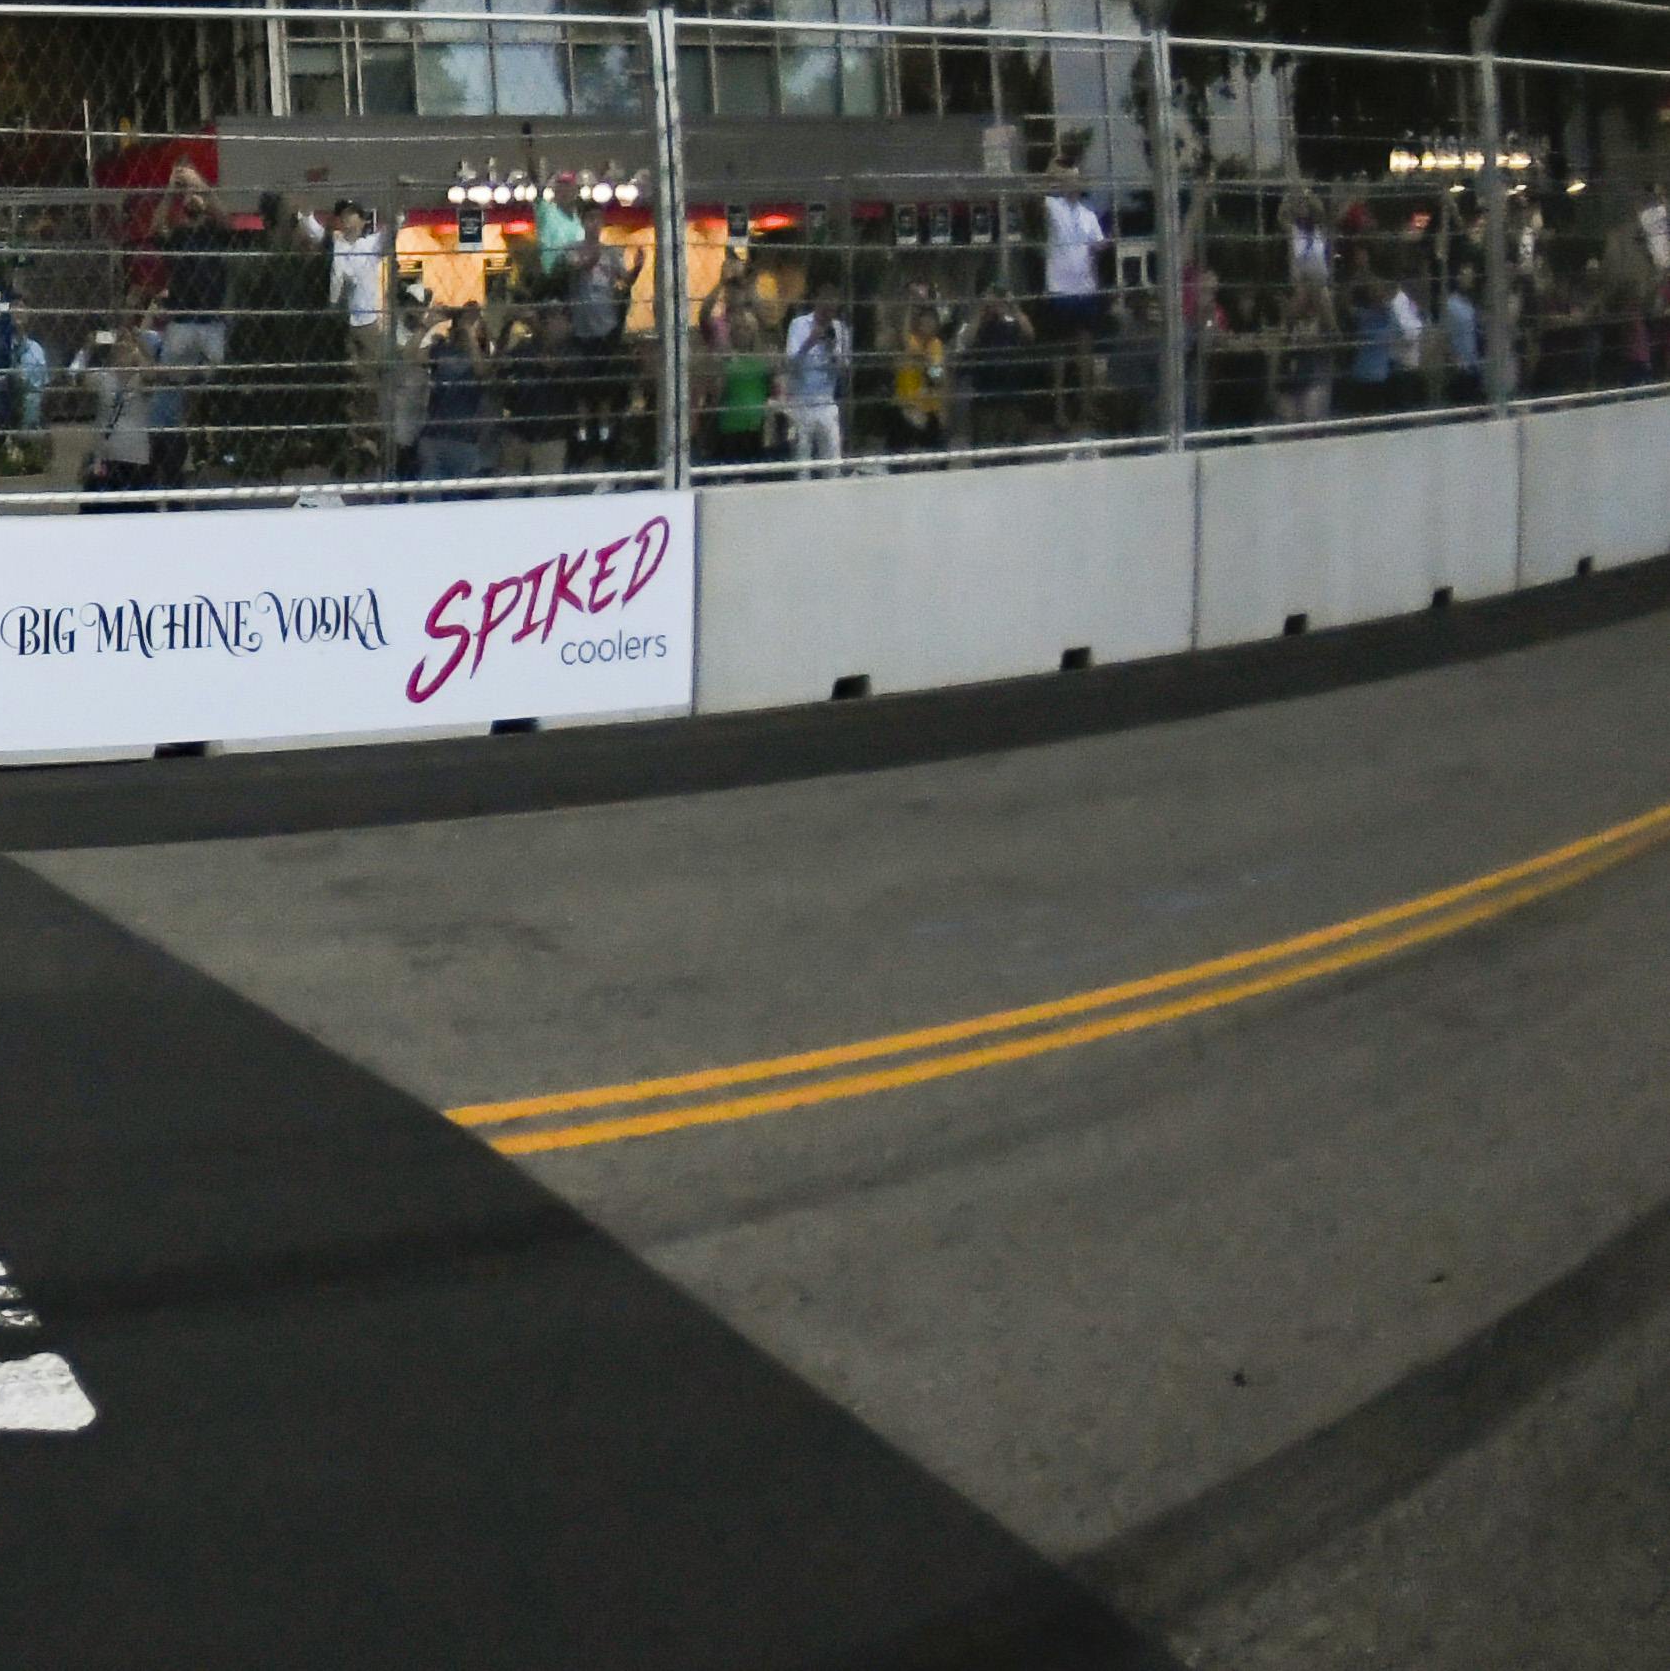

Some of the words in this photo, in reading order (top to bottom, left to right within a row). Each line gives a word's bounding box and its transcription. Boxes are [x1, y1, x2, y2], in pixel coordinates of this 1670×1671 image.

[0, 604, 76, 657] BIG
[80, 596, 264, 658] MACHINE
[256, 588, 390, 651] VODKA
[406, 515, 671, 704] SPIKED
[561, 628, 669, 666] coolers
